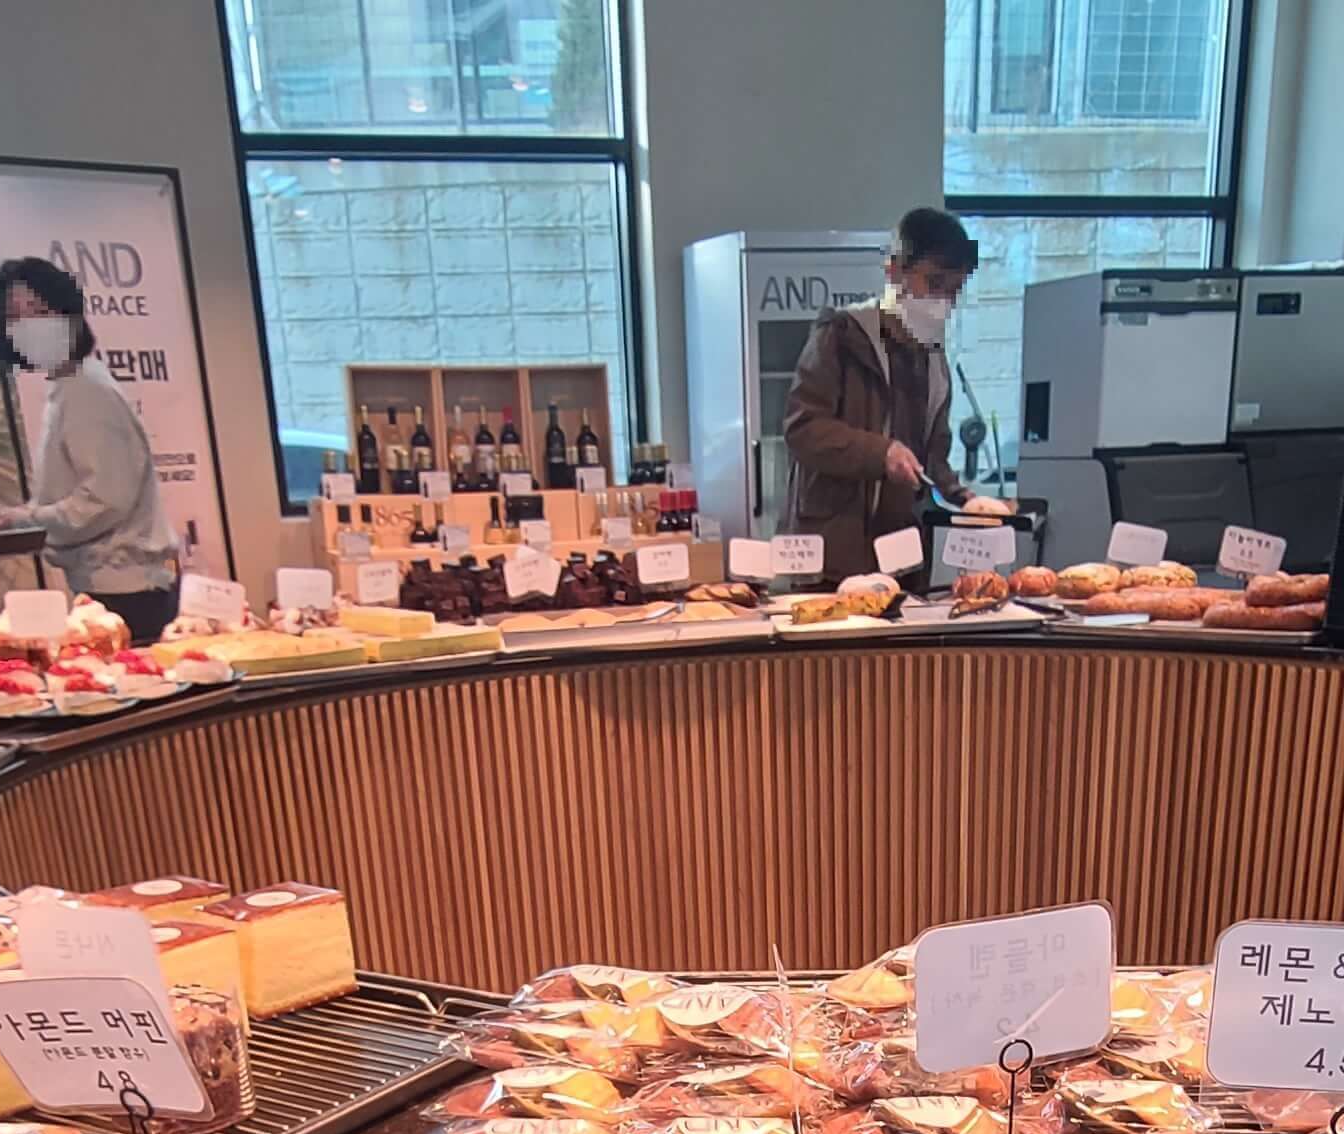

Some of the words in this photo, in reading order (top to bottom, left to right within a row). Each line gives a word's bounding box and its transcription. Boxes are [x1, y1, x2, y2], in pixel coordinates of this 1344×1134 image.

[760, 276, 829, 311] AND
[1240, 943, 1315, 983] 레몬
[105, 1009, 169, 1044] 머핀
